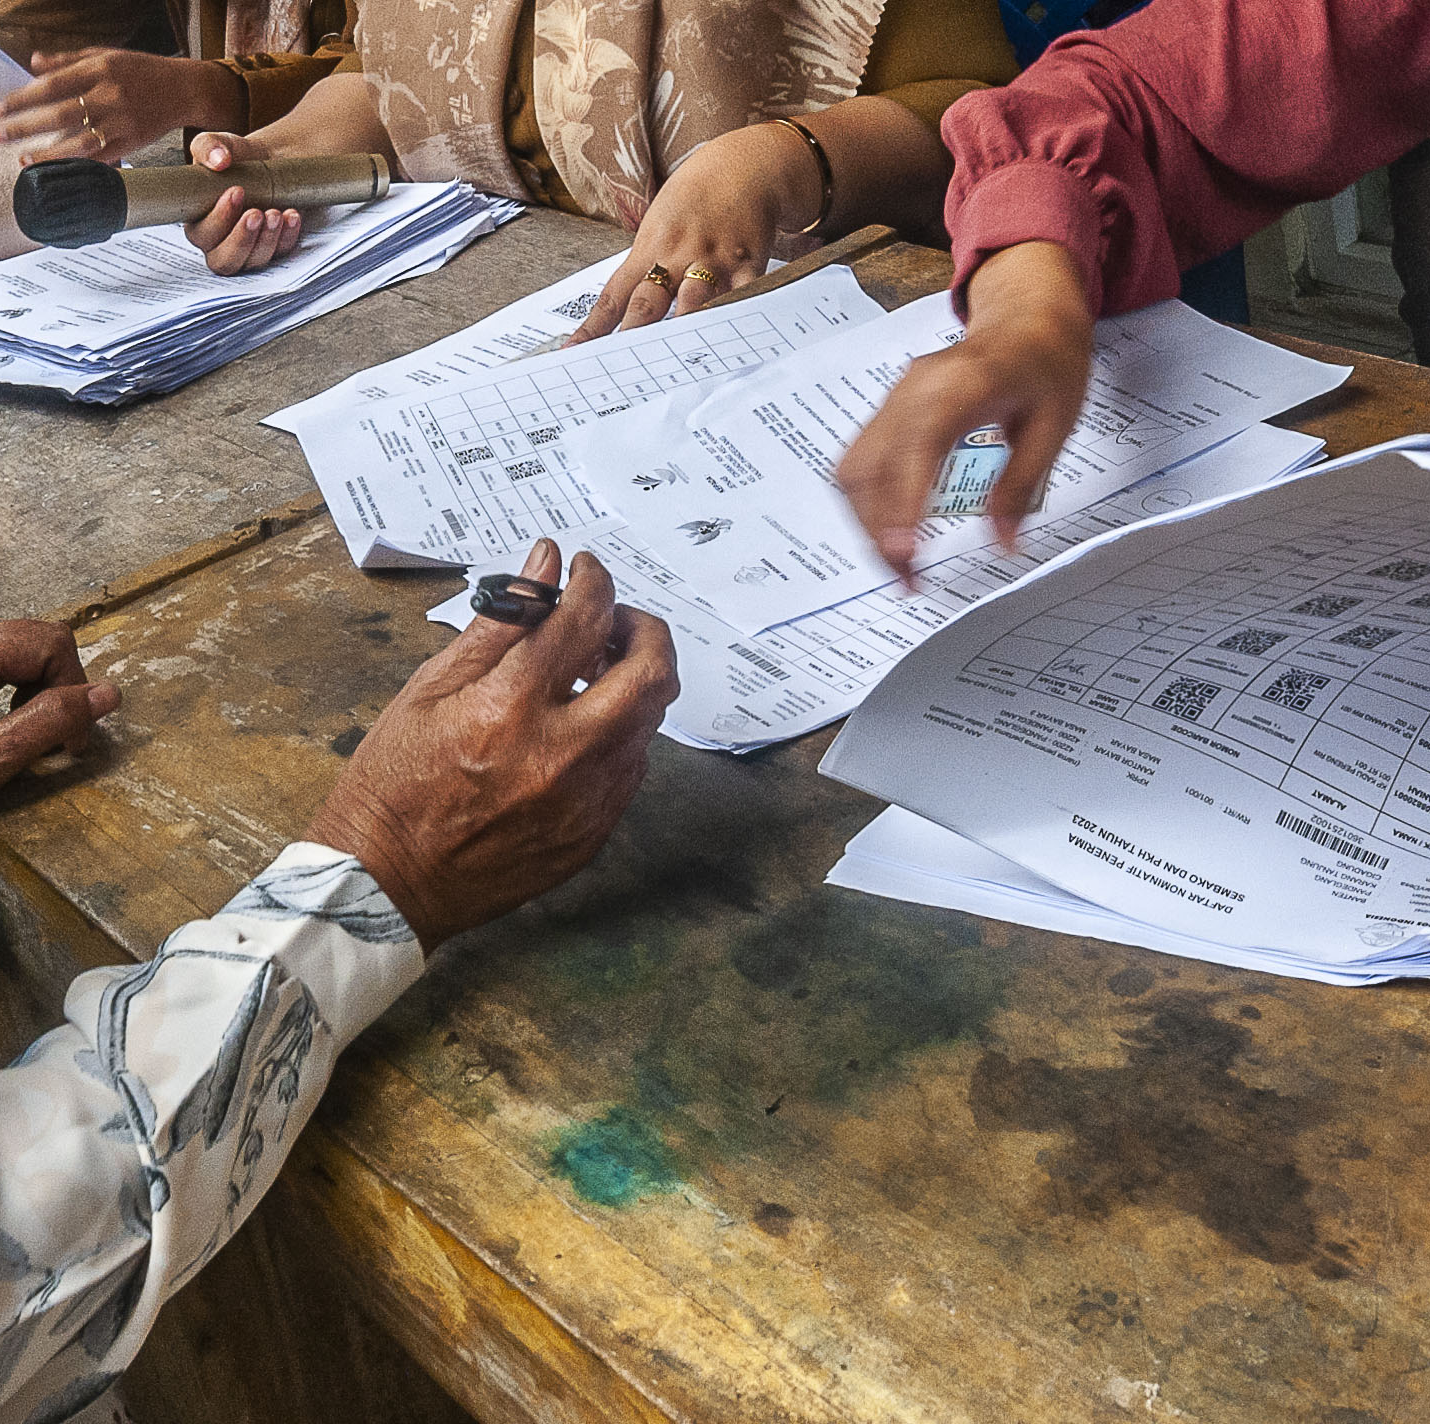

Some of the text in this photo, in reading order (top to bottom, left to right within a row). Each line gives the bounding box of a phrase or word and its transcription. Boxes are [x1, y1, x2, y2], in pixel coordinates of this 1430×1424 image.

[993, 717, 1048, 746] PANDEGLANG
[999, 710, 1054, 735] PANDEGLANG
[1170, 724, 1210, 746] BARCODE
[1110, 738, 1162, 765] MASA BAYAR
[1209, 740, 1241, 758] NOMOR
[1093, 745, 1156, 777] KANTOR BAYAR
[1126, 771, 1150, 787] KPRK
[1184, 786, 1251, 825] RW/RT 001/001
[1311, 789, 1347, 811] ALAMAT
[1310, 814, 1364, 844] 3601251002
[1392, 828, 1418, 844] NAMA
[1072, 813, 1245, 902] SEMBAKO DAN PKH TAHUN 2023
[1300, 857, 1339, 878] TANJUNG
[1067, 832, 1233, 914] DAFTAR NOMINATIF PENERIMA
[1336, 860, 1382, 880] CIGADUNG
[1339, 872, 1377, 888] KARANG
[1314, 874, 1372, 896] PANDEGLANG
[1332, 890, 1366, 904] BANTEN
[1365, 913, 1415, 926] INDONESIA
